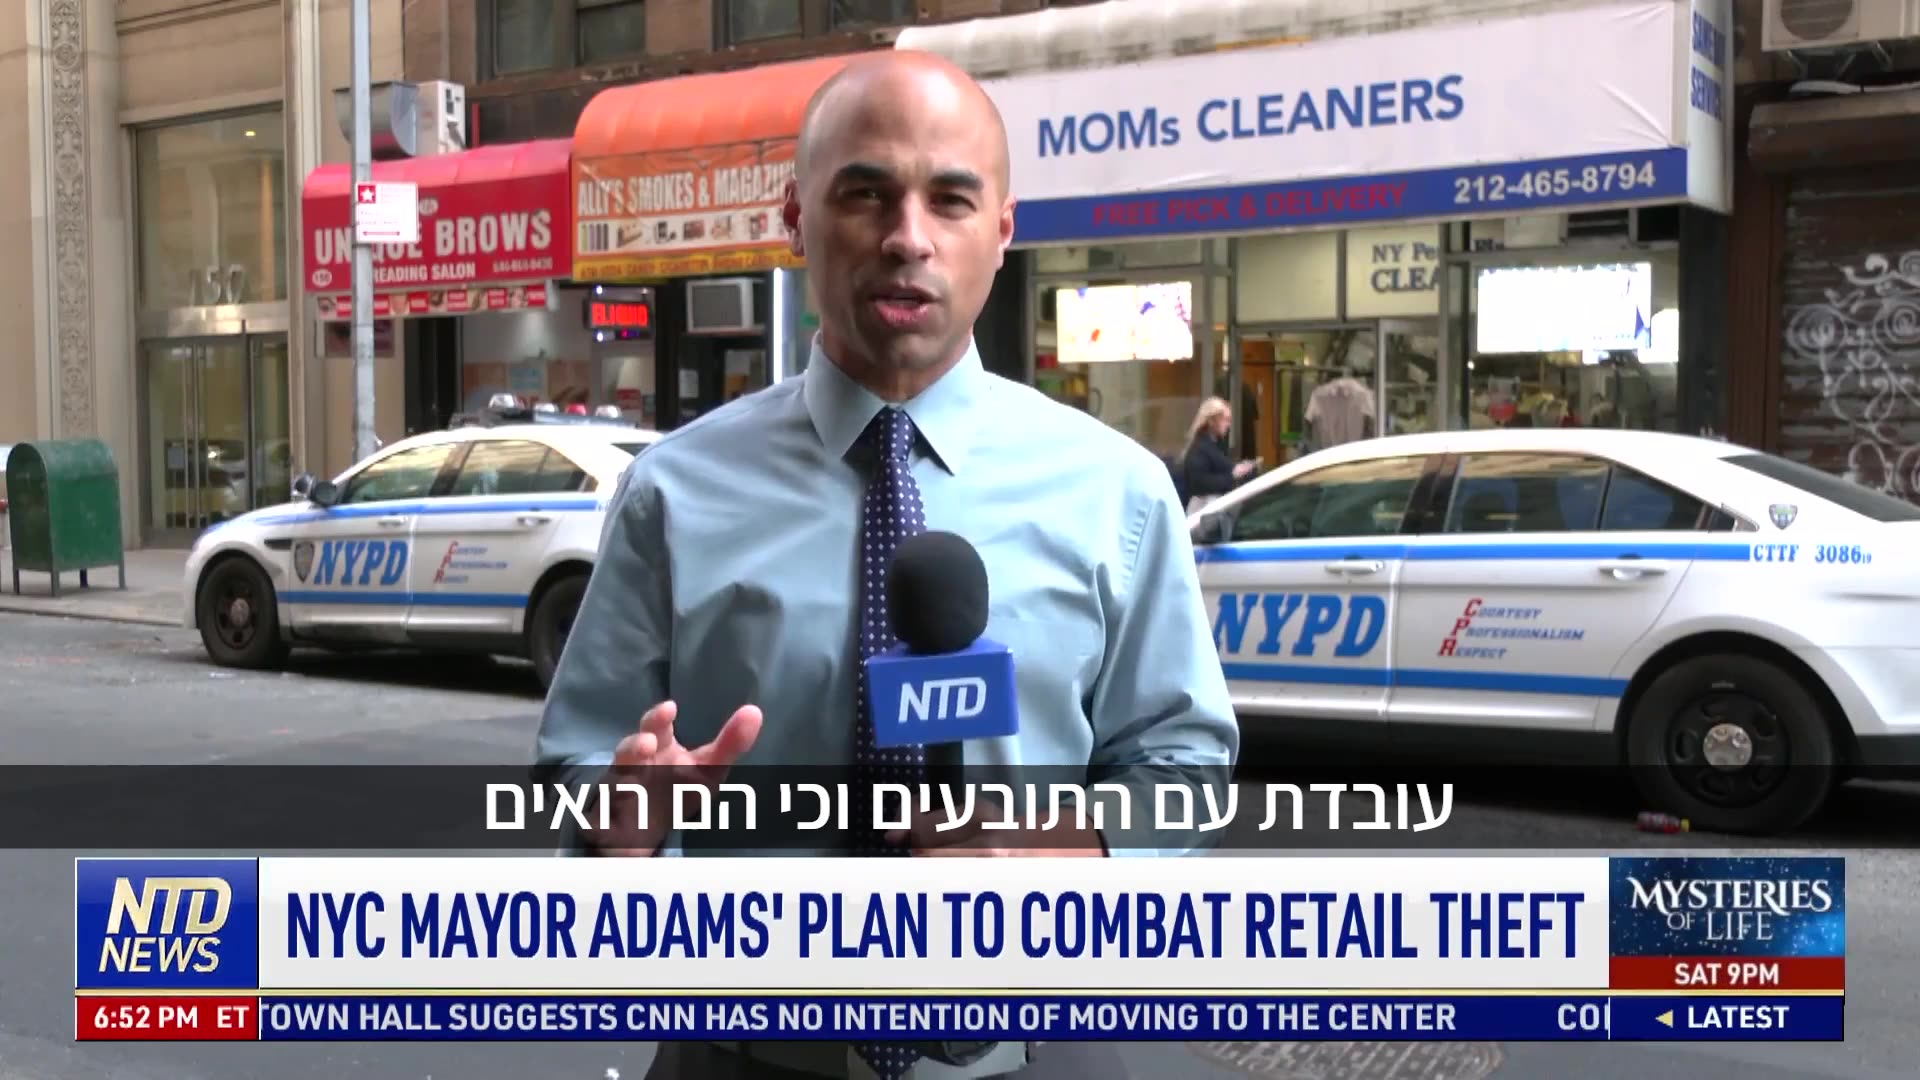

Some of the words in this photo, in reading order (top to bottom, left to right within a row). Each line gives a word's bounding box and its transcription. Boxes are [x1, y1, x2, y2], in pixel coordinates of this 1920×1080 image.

[1038, 107, 1179, 157] MOMs
[1198, 74, 1464, 143] CLEANERS
[578, 178, 624, 217] ALLY'S
[627, 171, 694, 214] SMOKES
[699, 176, 710, 208] &
[1092, 200, 1160, 227] FREE
[1167, 195, 1230, 223] PICK
[1238, 193, 1258, 219] &
[1265, 181, 1408, 216] DELIVERY
[1454, 160, 1656, 204] 212-465-8794
[435, 210, 552, 256] BROWS
[1372, 243, 1404, 263] NY
[432, 261, 476, 281] SALON
[314, 540, 408, 585] NYPD
[1753, 543, 1800, 563] CTTF
[1213, 592, 1386, 658] NYPD
[898, 676, 987, 723] NTD
